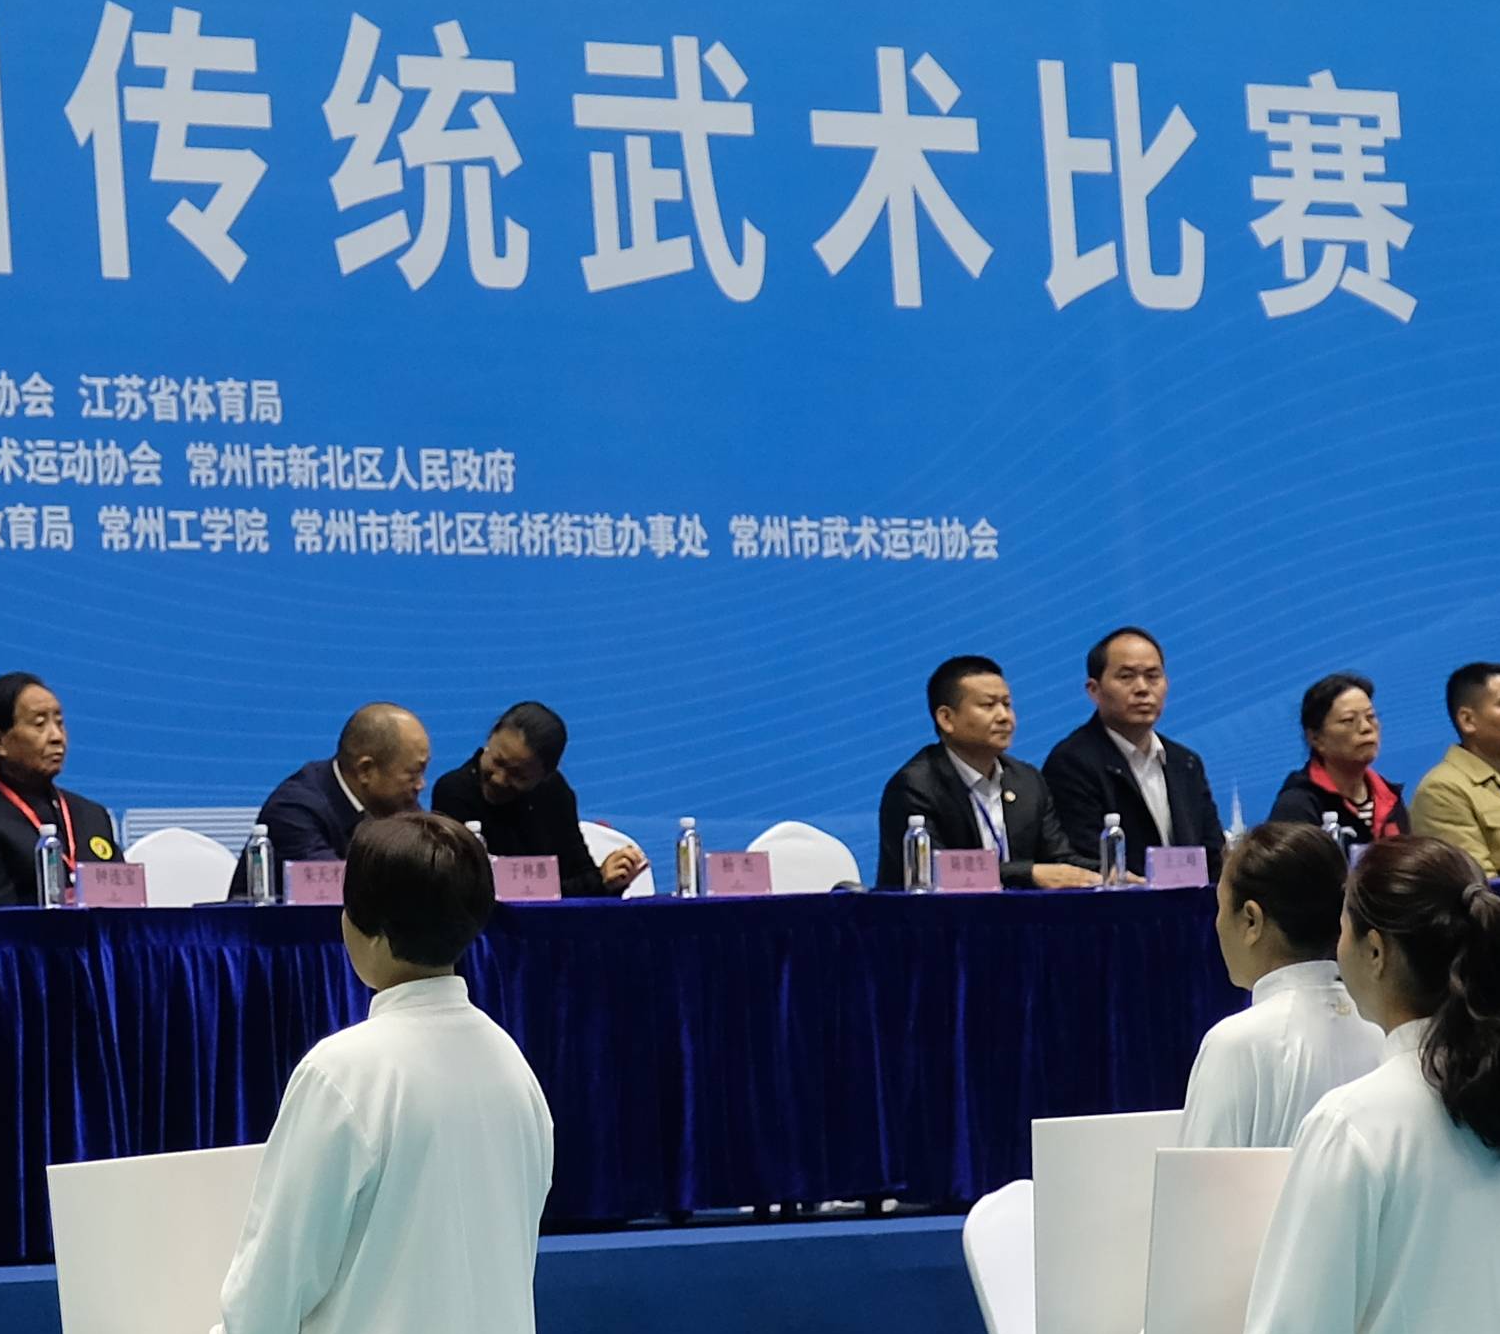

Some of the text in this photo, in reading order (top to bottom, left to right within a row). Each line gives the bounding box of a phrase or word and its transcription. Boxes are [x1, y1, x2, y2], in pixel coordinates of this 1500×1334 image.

[80, 375, 281, 423] 江苏省体育局
[187, 443, 514, 492] 常州市新北区人民政府
[99, 506, 268, 551] 常州工学院
[292, 509, 708, 557] 常州市新北区新桥街道办事处
[730, 516, 997, 560] 常州市武术运动协会
